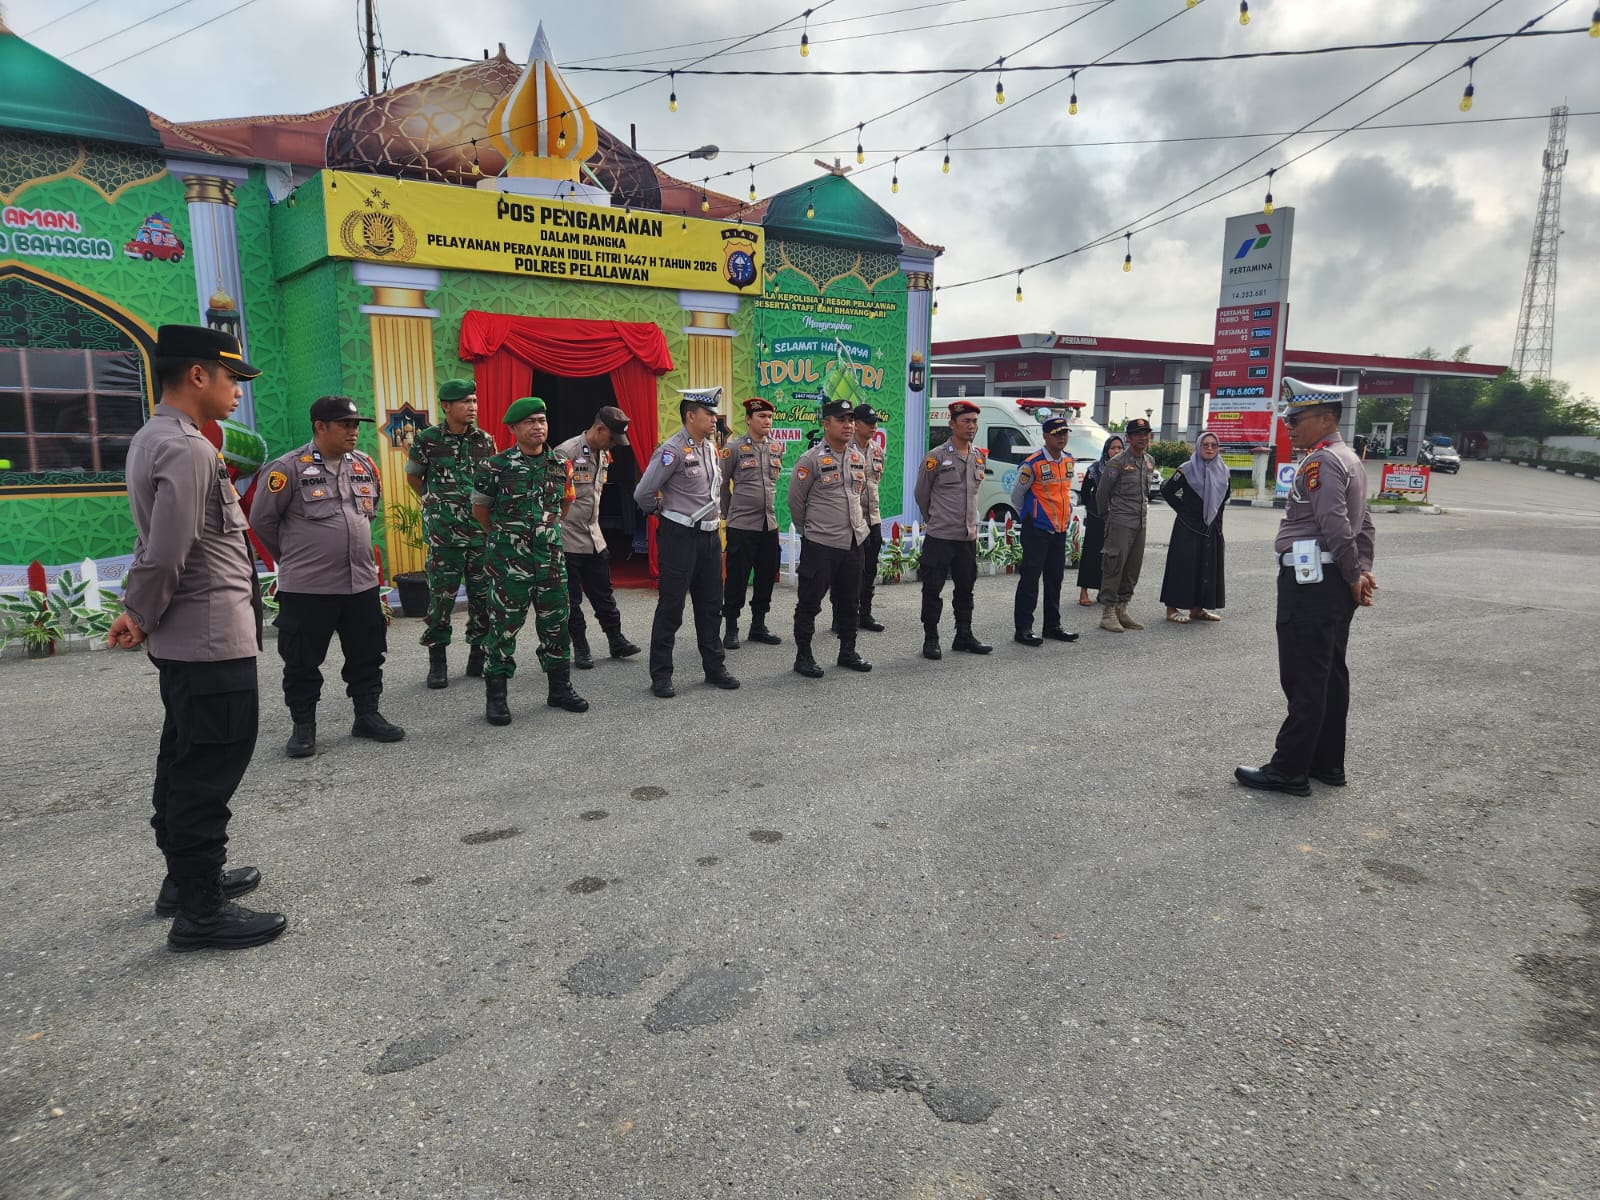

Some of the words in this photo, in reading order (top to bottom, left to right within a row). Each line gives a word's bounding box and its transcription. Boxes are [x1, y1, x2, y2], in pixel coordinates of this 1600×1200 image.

[4, 208, 80, 231] AMAN.
[497, 200, 534, 223] POS
[541, 206, 662, 237] PENGAMANAN
[15, 234, 111, 257] BAHAGIA
[541, 230, 579, 245] DALAM
[583, 233, 626, 249] RANGKA
[725, 231, 754, 239] RIAU
[427, 233, 500, 253] PELAYANAN
[503, 242, 564, 259] PERAYAAN
[568, 249, 592, 262] IDUL
[596, 252, 621, 264] FITRI
[624, 254, 648, 267] 1447
[650, 257, 656, 267] H
[659, 257, 691, 270] TAHUN
[694, 260, 717, 272] 2026
[515, 258, 566, 275] POLRES
[570, 262, 649, 281] PELALAWAN
[1229, 262, 1273, 275] PERTAMINA
[792, 303, 814, 312] STAFF
[834, 306, 886, 318] BHAYANGARI
[826, 297, 851, 306] RESOR
[853, 300, 896, 310] PELALAWAN
[774, 341, 817, 353] SELAMAT
[758, 358, 819, 386] IDUL
